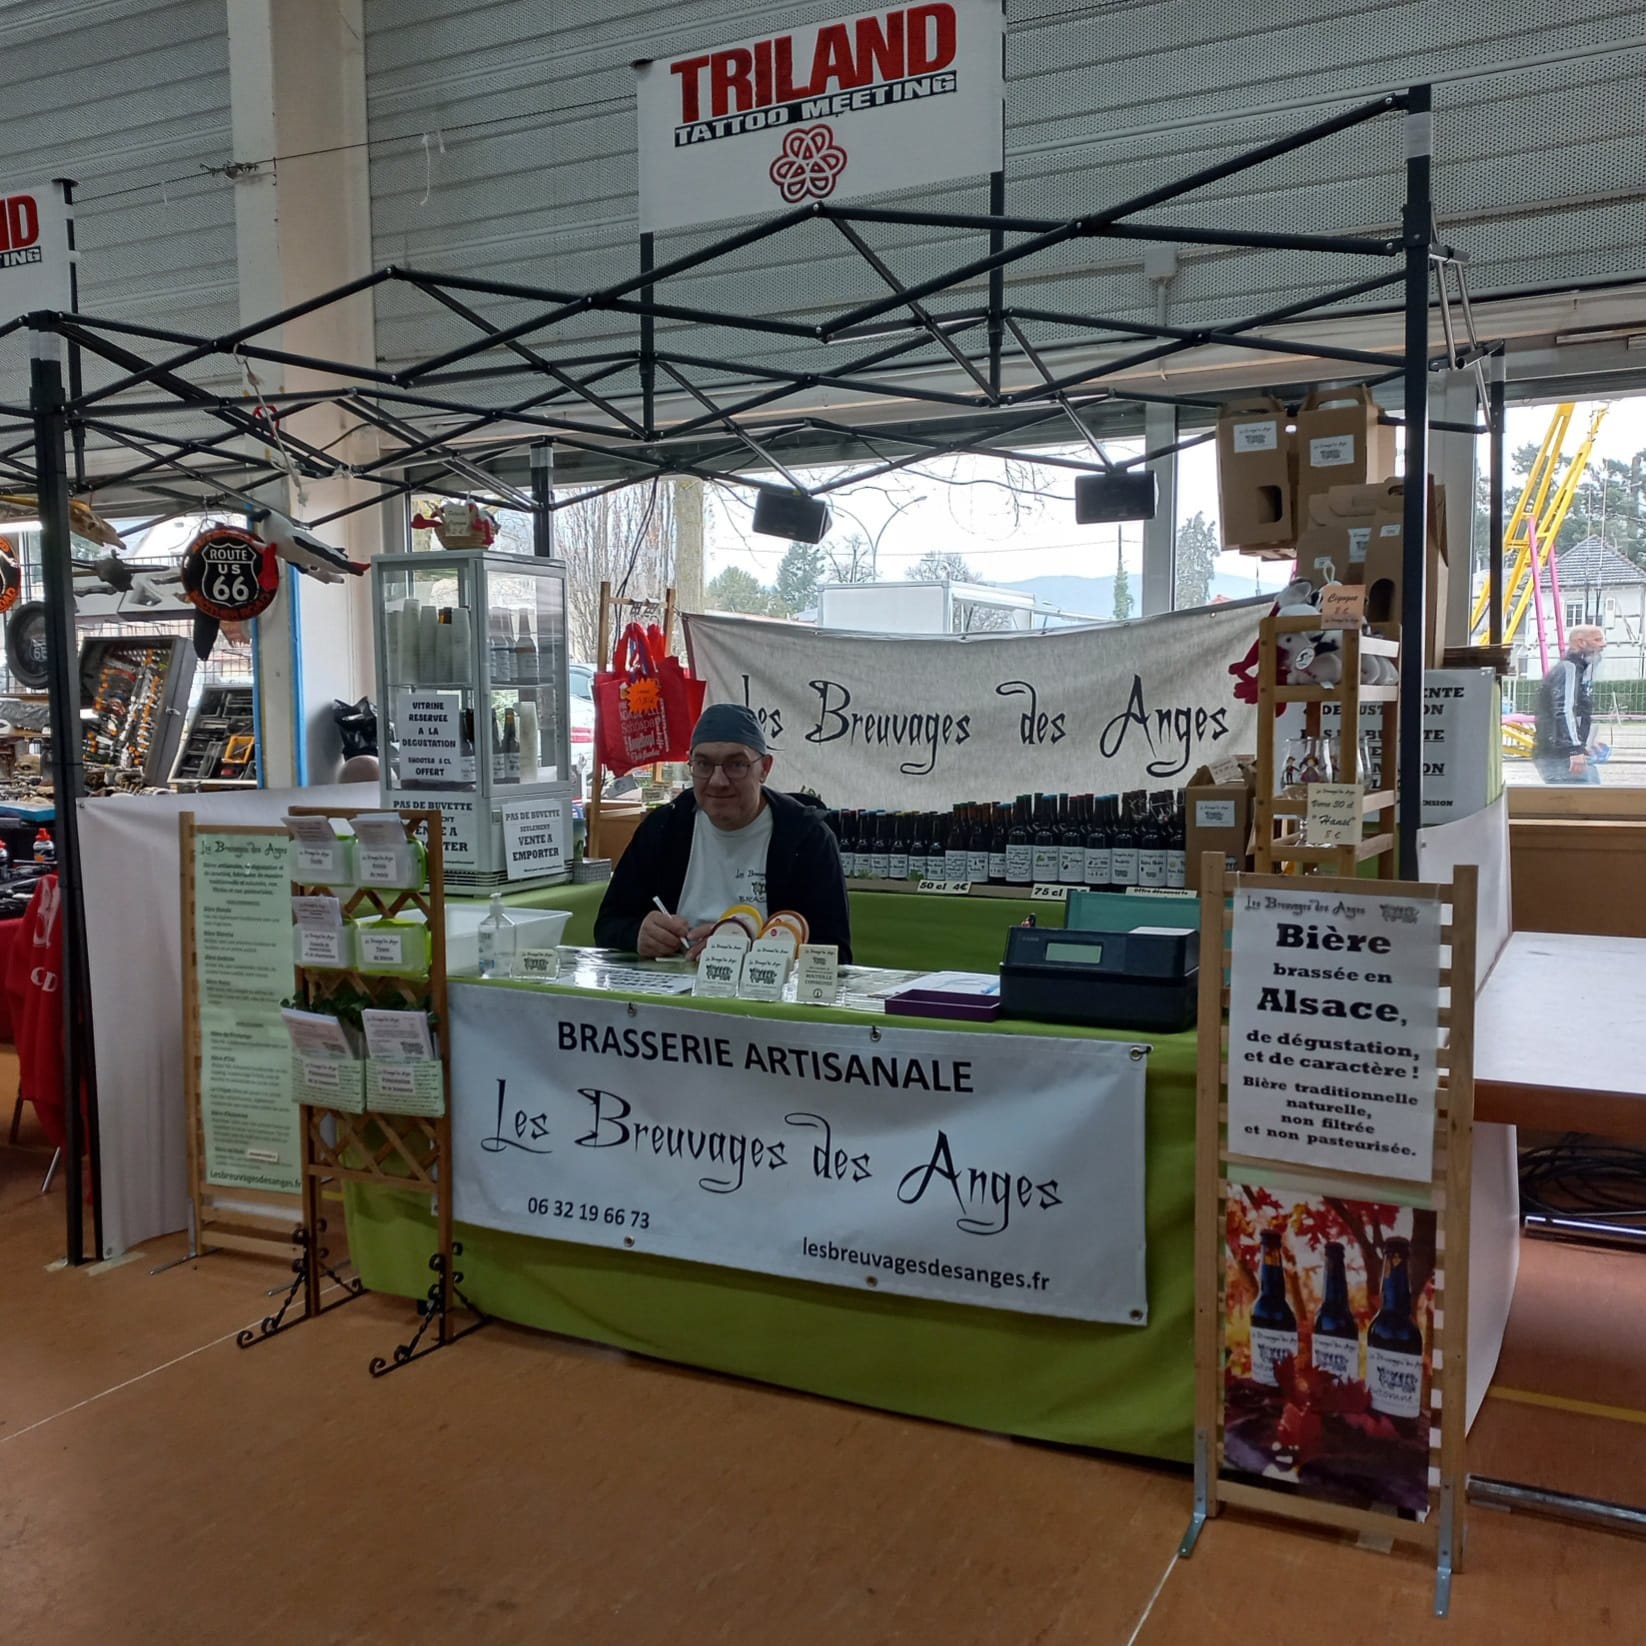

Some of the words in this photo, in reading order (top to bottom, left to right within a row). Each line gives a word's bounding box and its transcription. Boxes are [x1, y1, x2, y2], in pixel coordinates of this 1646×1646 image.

[670, 2, 957, 124] TRILAND
[675, 106, 789, 146] TATTOO
[802, 71, 957, 119] MEETING
[210, 549, 248, 561] ROUTE
[218, 564, 241, 574] US
[213, 575, 249, 601] 66
[412, 702, 445, 710] VITRINE
[408, 713, 448, 722] RESERVEE
[805, 679, 971, 775] Breuvages
[996, 681, 1066, 744] des
[1100, 674, 1229, 778] Anges
[418, 727, 425, 735] A
[428, 727, 439, 735] LA
[402, 738, 456, 748] DEGUSTATION
[415, 768, 445, 776] OFFERT
[393, 800, 411, 809] PAS
[413, 801, 425, 809] DE
[427, 801, 473, 811] BUVETTE
[505, 812, 519, 821] PAS
[520, 811, 531, 820] DE
[531, 809, 561, 820] BUVETTE
[449, 827, 458, 836] A
[518, 835, 546, 846] VENTE
[546, 834, 553, 843] A
[512, 847, 559, 861] EMPORTER
[919, 881, 934, 890] 50
[935, 882, 946, 890] cl
[952, 883, 969, 891] 4€
[1034, 887, 1050, 896] 75
[1051, 888, 1064, 896] cl
[1244, 895, 1261, 911] Les
[1276, 922, 1392, 955] Bière
[1273, 962, 1360, 982] brassée
[1364, 971, 1393, 984] en
[1257, 987, 1408, 1026] Alsace,
[1246, 1029, 1272, 1044] de
[1277, 1032, 1421, 1061] dégustation,
[557, 1021, 734, 1068] BRASSERIE
[744, 1042, 974, 1093] ARTISANALE
[1244, 1051, 1264, 1063] et
[1269, 1053, 1295, 1066] de
[1300, 1056, 1407, 1079] caractère
[1243, 1076, 1287, 1091] Bière
[1295, 1081, 1418, 1106] traditionnelle
[1286, 1098, 1373, 1120] naturelle,
[1281, 1113, 1315, 1126] non
[1321, 1117, 1375, 1135] filtrée
[1244, 1124, 1260, 1135] et
[1267, 1128, 1300, 1141] non
[1307, 1133, 1416, 1156] pasteurisée.
[480, 1078, 553, 1154] Les
[574, 1088, 788, 1194] Breuvages
[784, 1112, 872, 1183] des
[897, 1130, 1064, 1236] Anges
[527, 1197, 549, 1215] 06
[553, 1199, 574, 1218] 32
[579, 1203, 599, 1221] 19
[603, 1206, 625, 1226] 66
[631, 1210, 651, 1229] 73
[802, 1236, 1050, 1291] lesbreuvagesdesanges.fr
